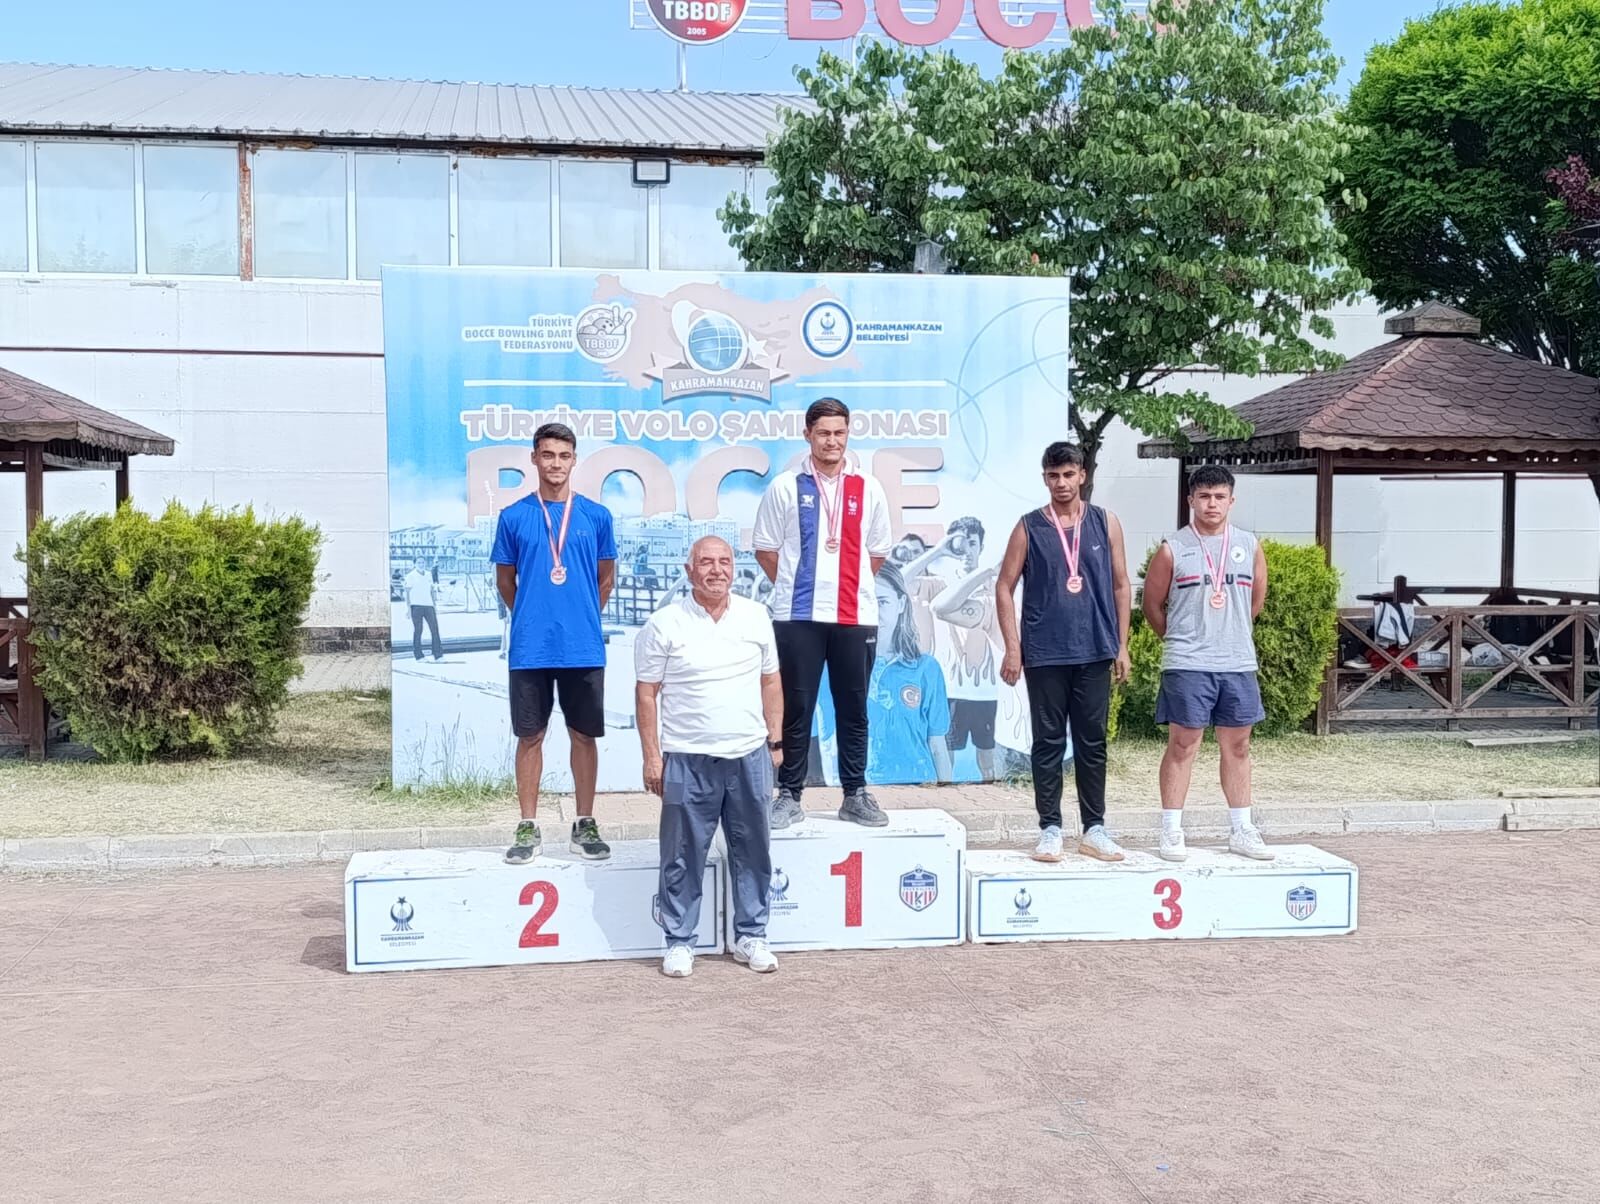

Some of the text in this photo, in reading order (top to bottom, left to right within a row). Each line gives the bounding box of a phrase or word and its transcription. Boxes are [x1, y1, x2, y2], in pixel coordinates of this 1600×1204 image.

[663, 0, 731, 21] TBBDF
[687, 27, 707, 36] 2005
[532, 316, 573, 327] TÜRKİYE
[856, 323, 942, 331] KAHRAMANKAZAN
[465, 329, 573, 339] BOCCE BOWLING DART
[856, 332, 909, 341] BELEDİYESİ
[504, 340, 573, 349] FEDERASYONU
[671, 377, 764, 392] KAHRAMANKAZAN
[464, 408, 947, 441] TÜRKİYE VOLO ŞAMONASI
[1204, 573, 1233, 585] BU
[830, 851, 863, 927] 1
[1152, 878, 1183, 930] 3
[518, 880, 560, 948] 2
